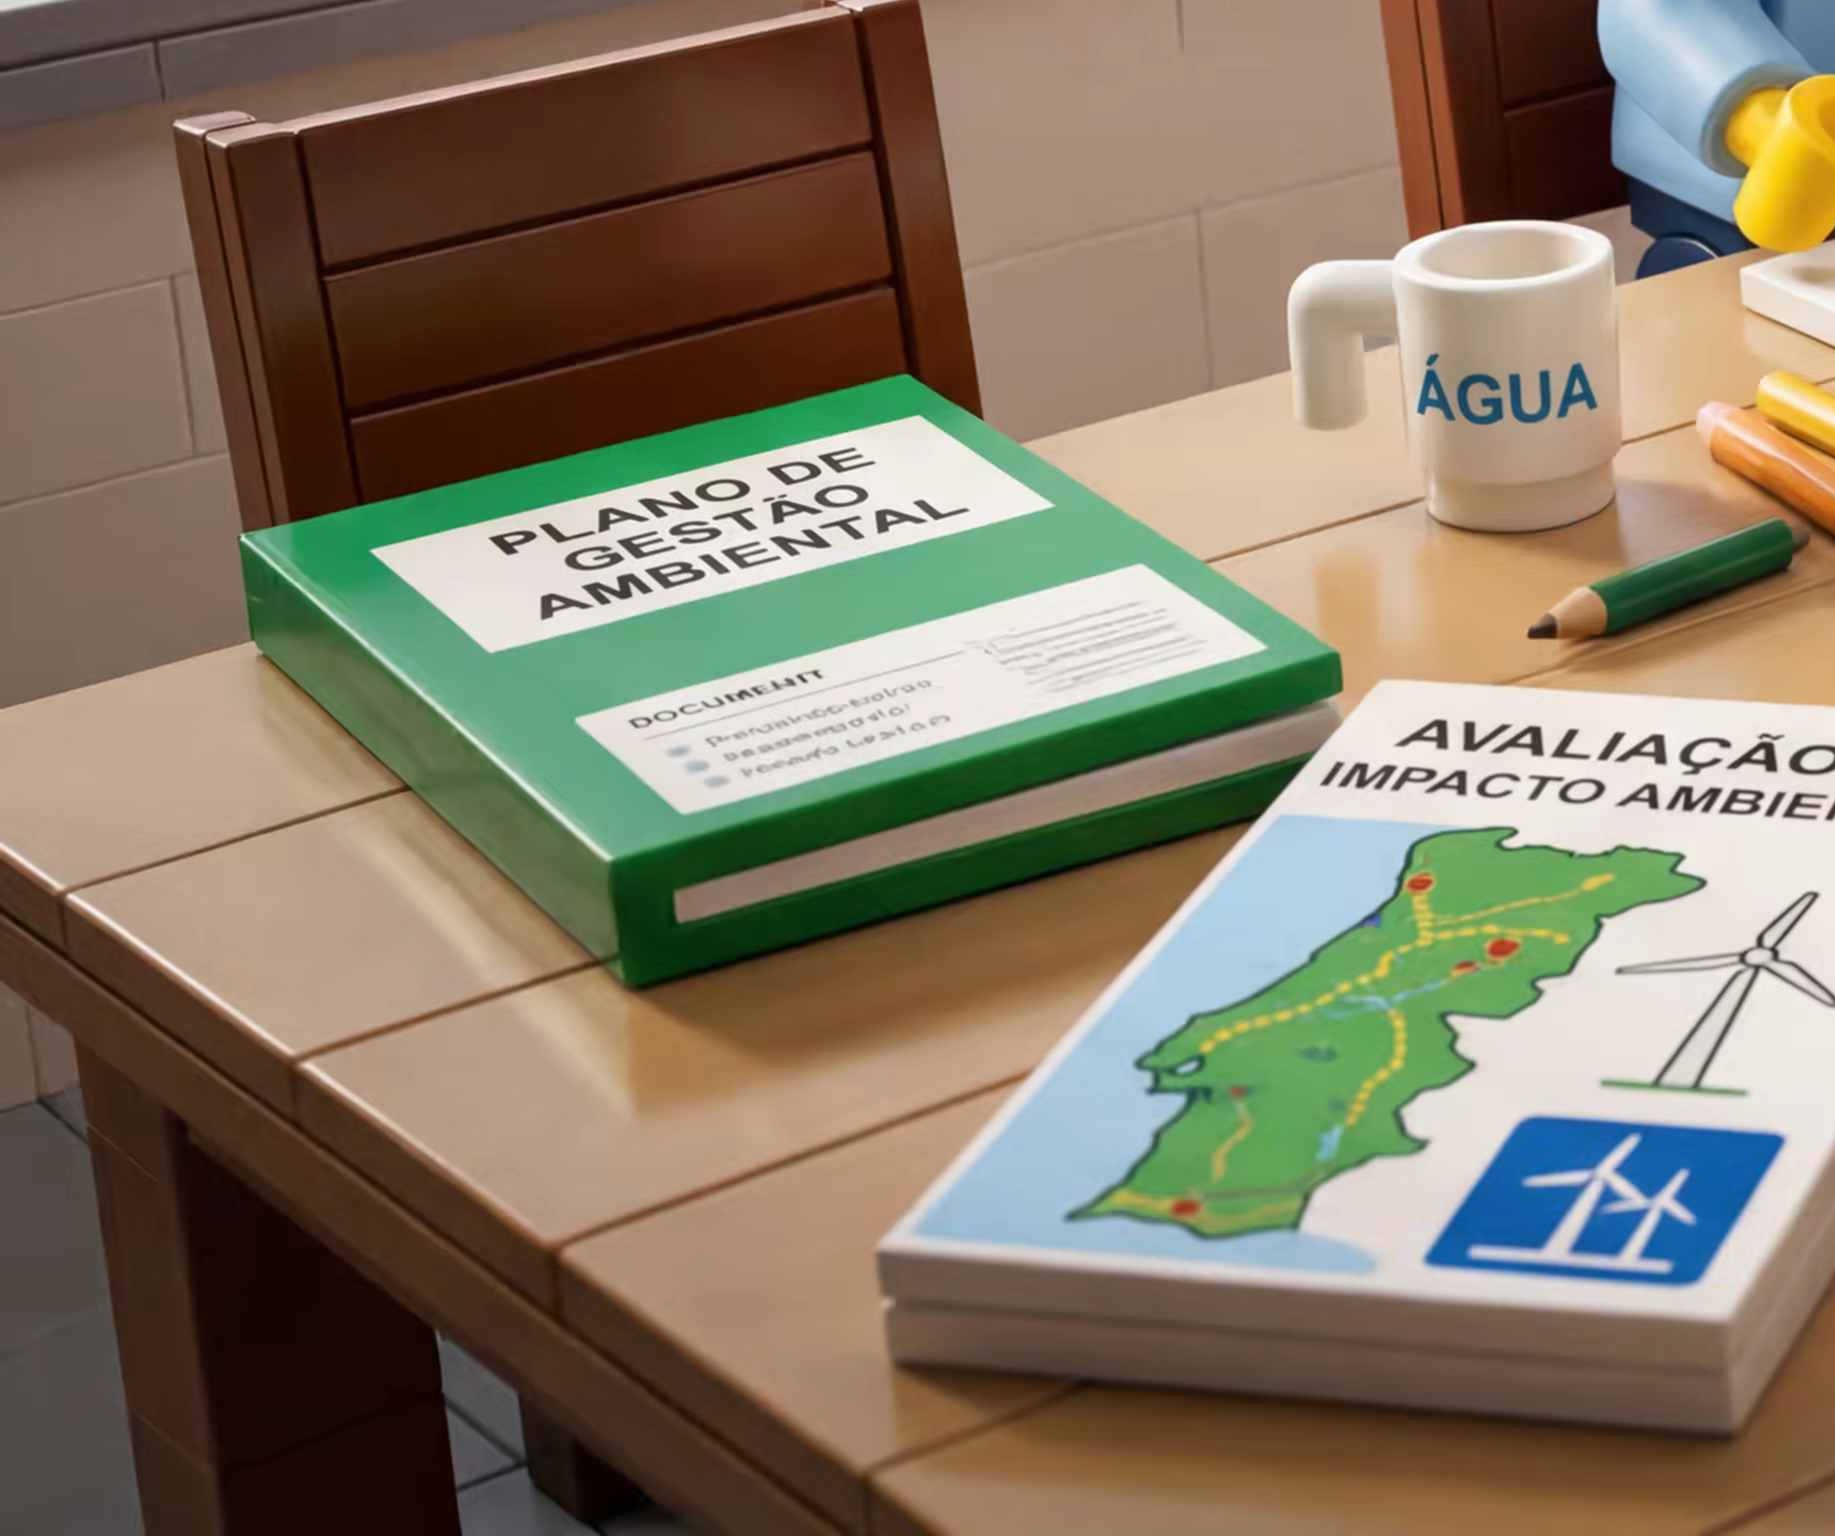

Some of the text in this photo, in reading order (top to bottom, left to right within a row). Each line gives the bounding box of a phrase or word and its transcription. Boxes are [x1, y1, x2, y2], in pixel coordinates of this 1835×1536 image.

[1416, 353, 1598, 426] ÁGUA
[488, 447, 877, 556] PLANO DE
[540, 498, 971, 621] AMBIENTAL
[1319, 761, 1606, 806] IMPACTO
